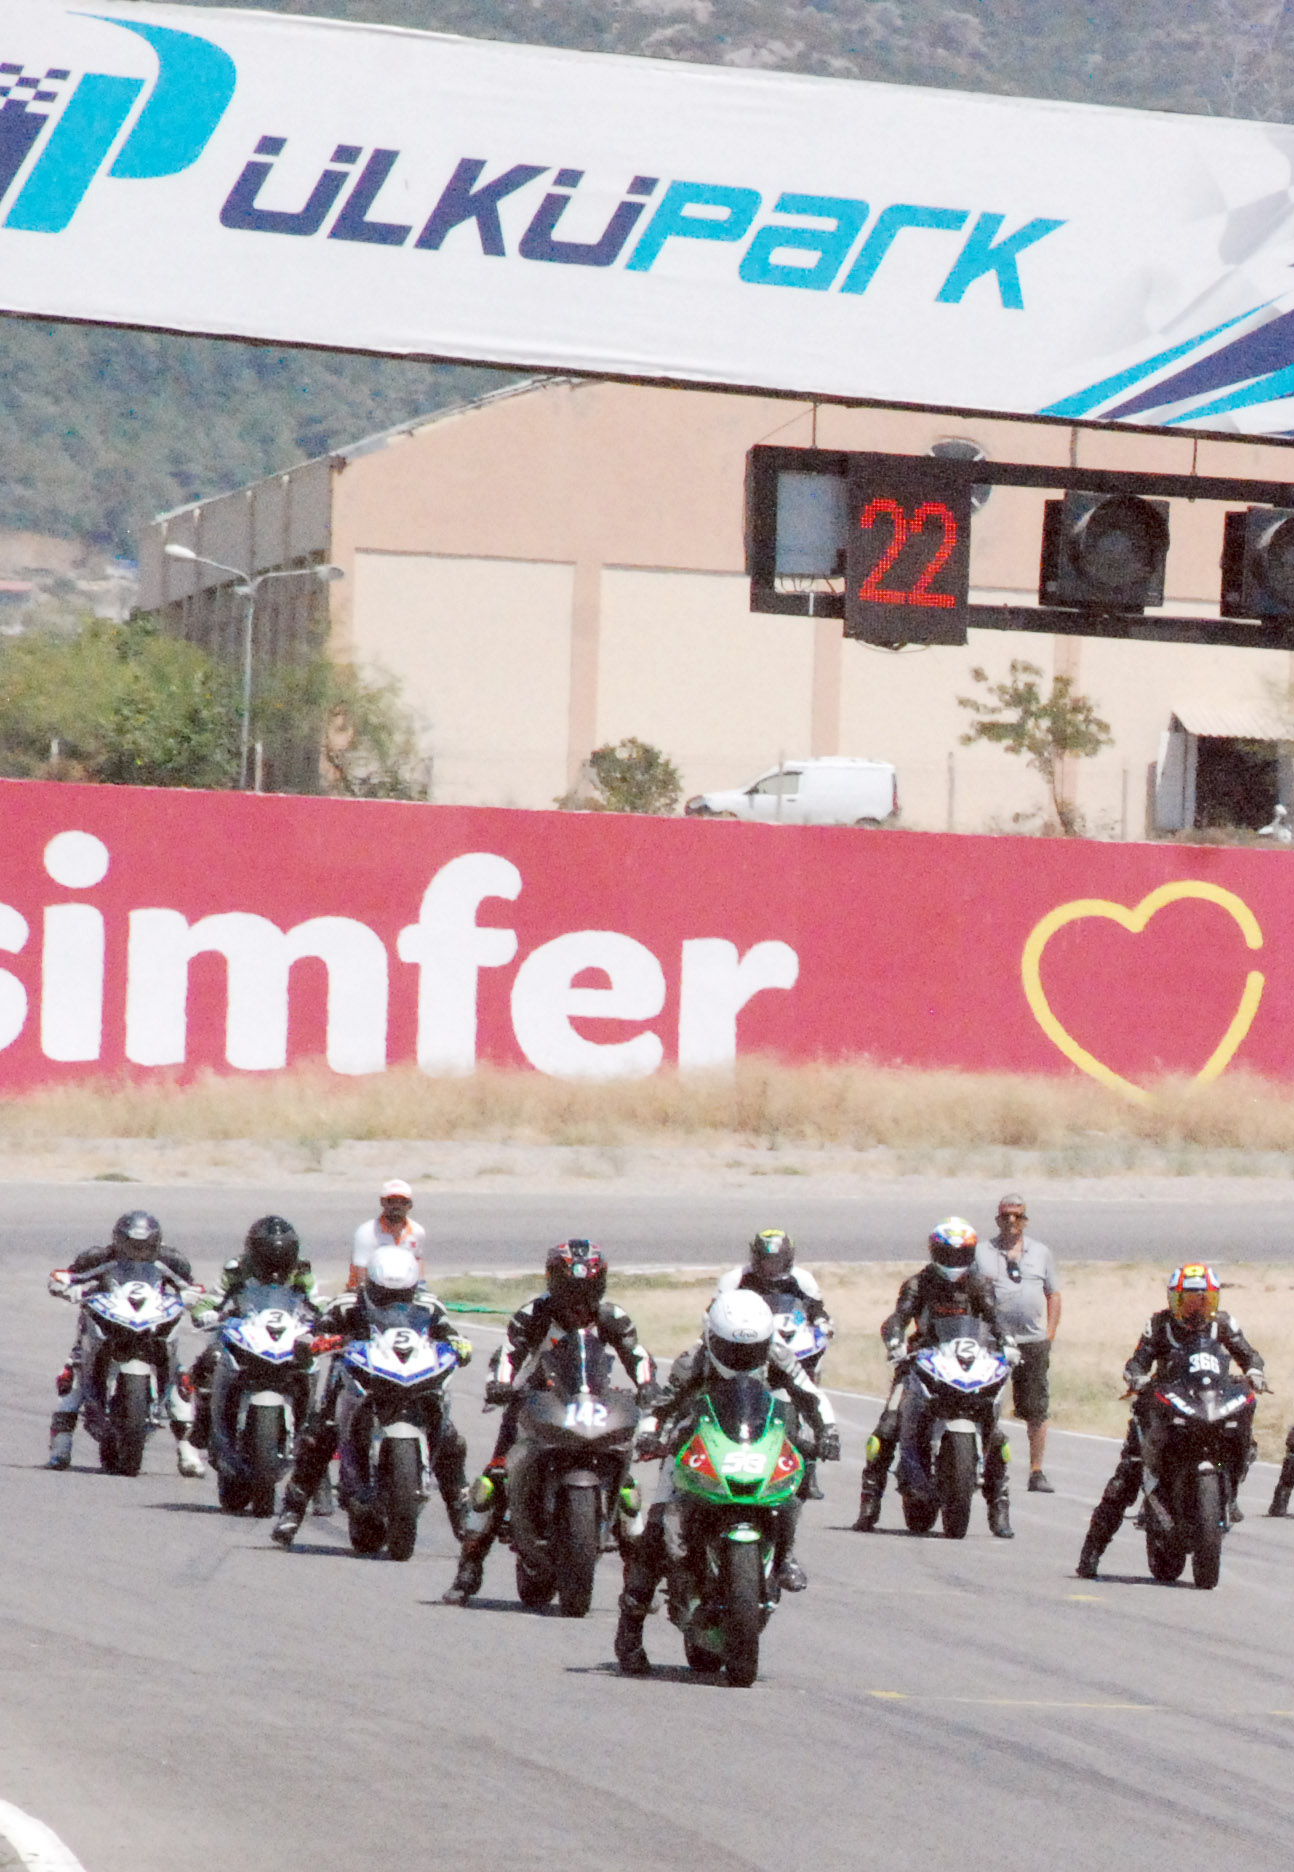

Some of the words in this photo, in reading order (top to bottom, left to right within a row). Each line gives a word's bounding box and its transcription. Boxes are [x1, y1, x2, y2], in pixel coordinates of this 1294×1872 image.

[858, 497, 958, 609] 22
[0, 829, 801, 1083] imfer
[954, 1340, 977, 1355] 12
[1188, 1351, 1221, 1375] 366
[563, 1400, 609, 1428] 142
